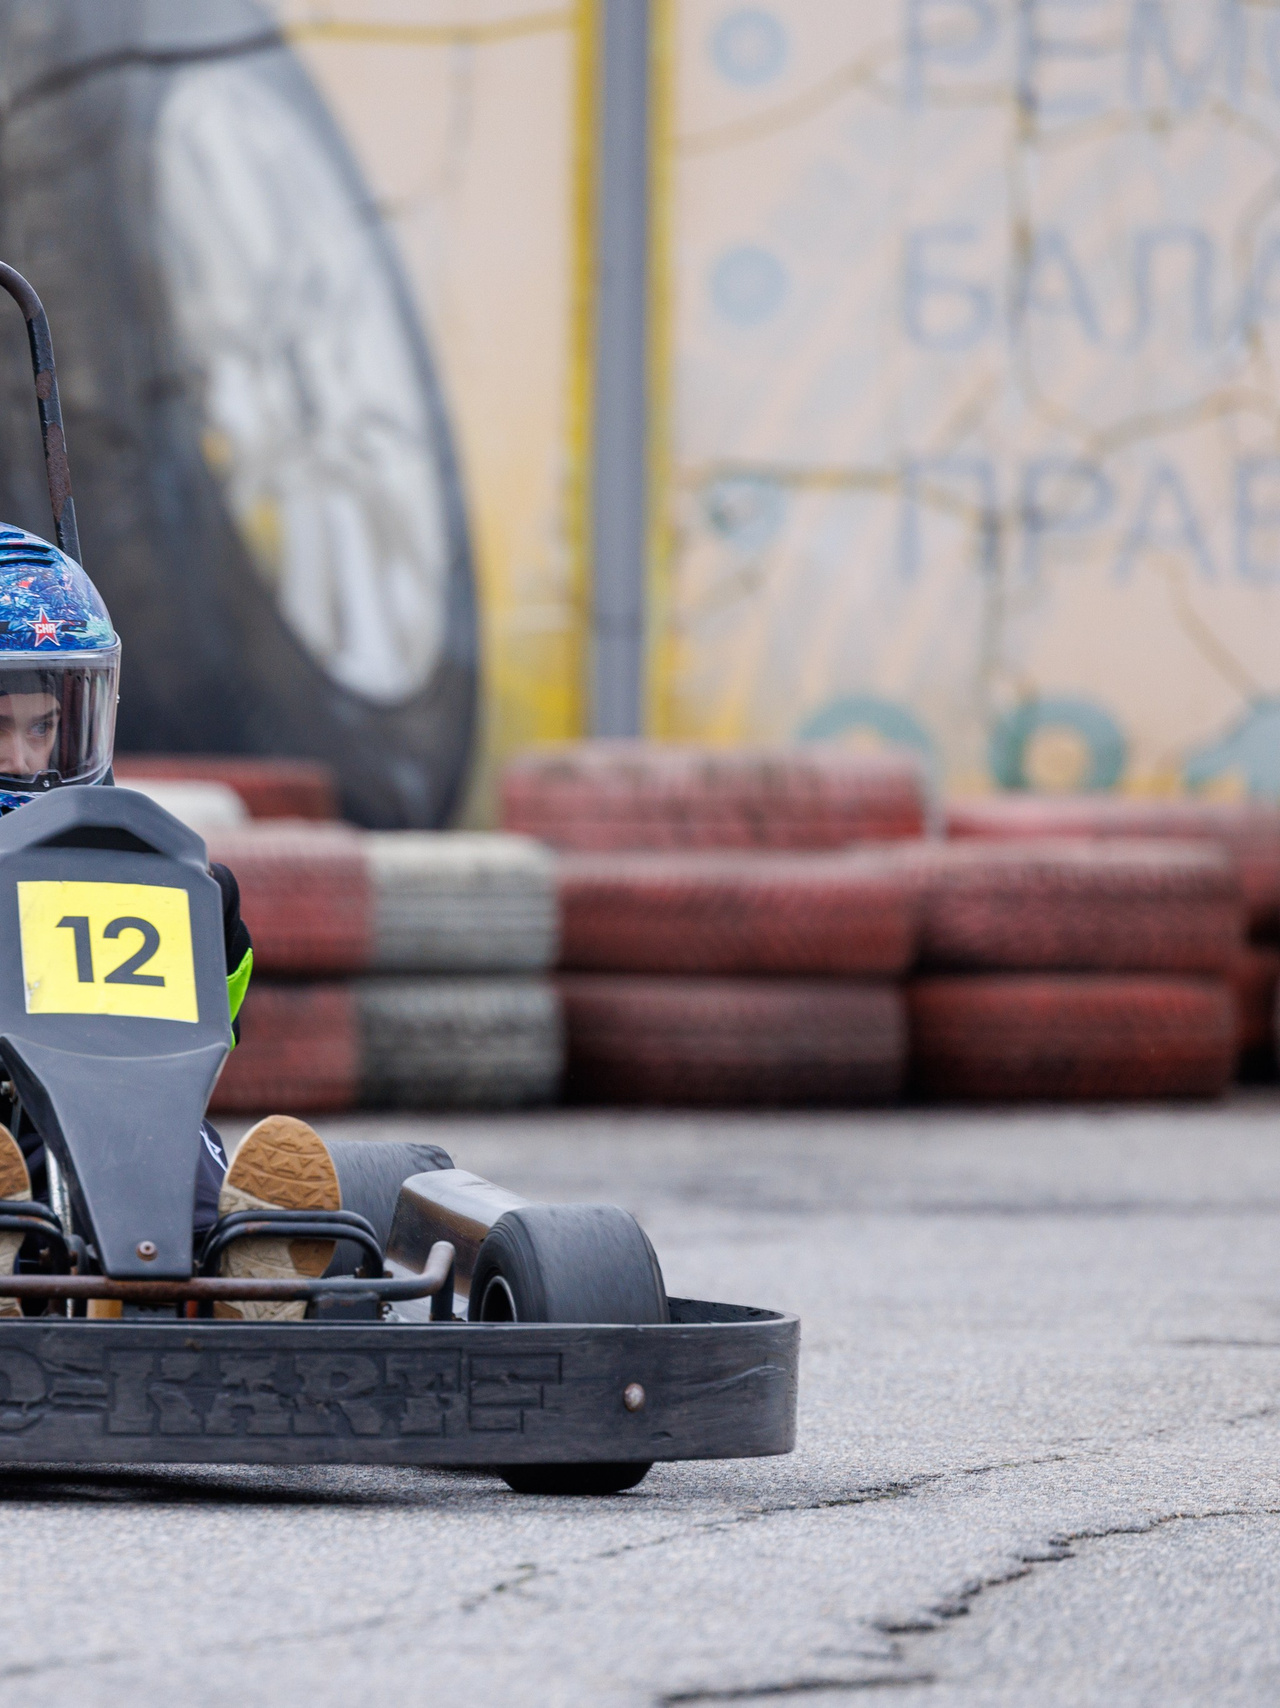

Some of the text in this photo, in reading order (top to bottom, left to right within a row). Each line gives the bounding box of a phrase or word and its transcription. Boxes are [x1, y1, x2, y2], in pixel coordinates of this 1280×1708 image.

[901, 0, 1280, 116] РЕМ
[55, 915, 166, 988] 12
[107, 1349, 462, 1436] KART
